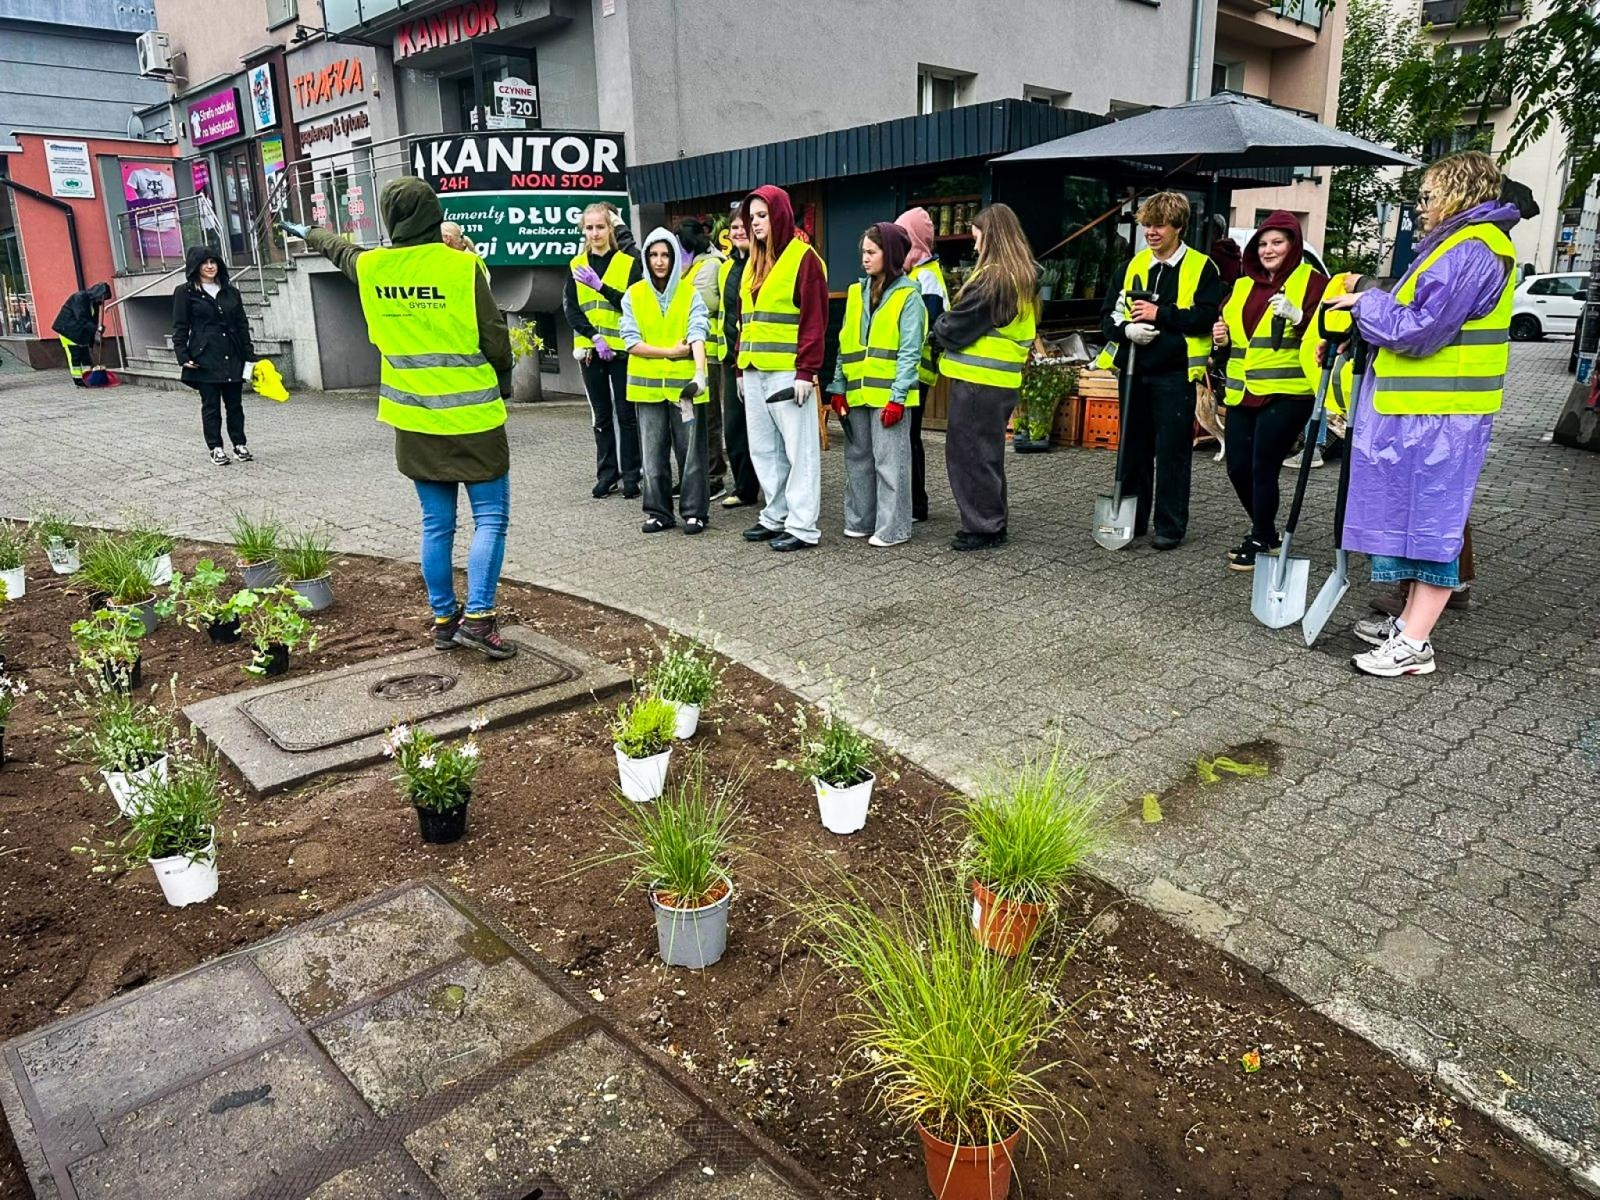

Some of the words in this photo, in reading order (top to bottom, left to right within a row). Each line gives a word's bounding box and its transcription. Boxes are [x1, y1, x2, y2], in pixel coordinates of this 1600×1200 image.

[396, 1, 499, 58] KANTOR
[498, 85, 532, 97] CZYNNE
[431, 136, 620, 176] KANTOR
[440, 176, 469, 191] 24H
[511, 174, 556, 188] NON
[560, 174, 604, 188] STOP
[444, 205, 505, 225] tamenty
[508, 206, 583, 225] DŁUG
[518, 226, 566, 236] Racibórz
[506, 237, 586, 260] wynaj
[375, 285, 446, 300] NIVEL
[409, 302, 447, 310] SYSTEM
